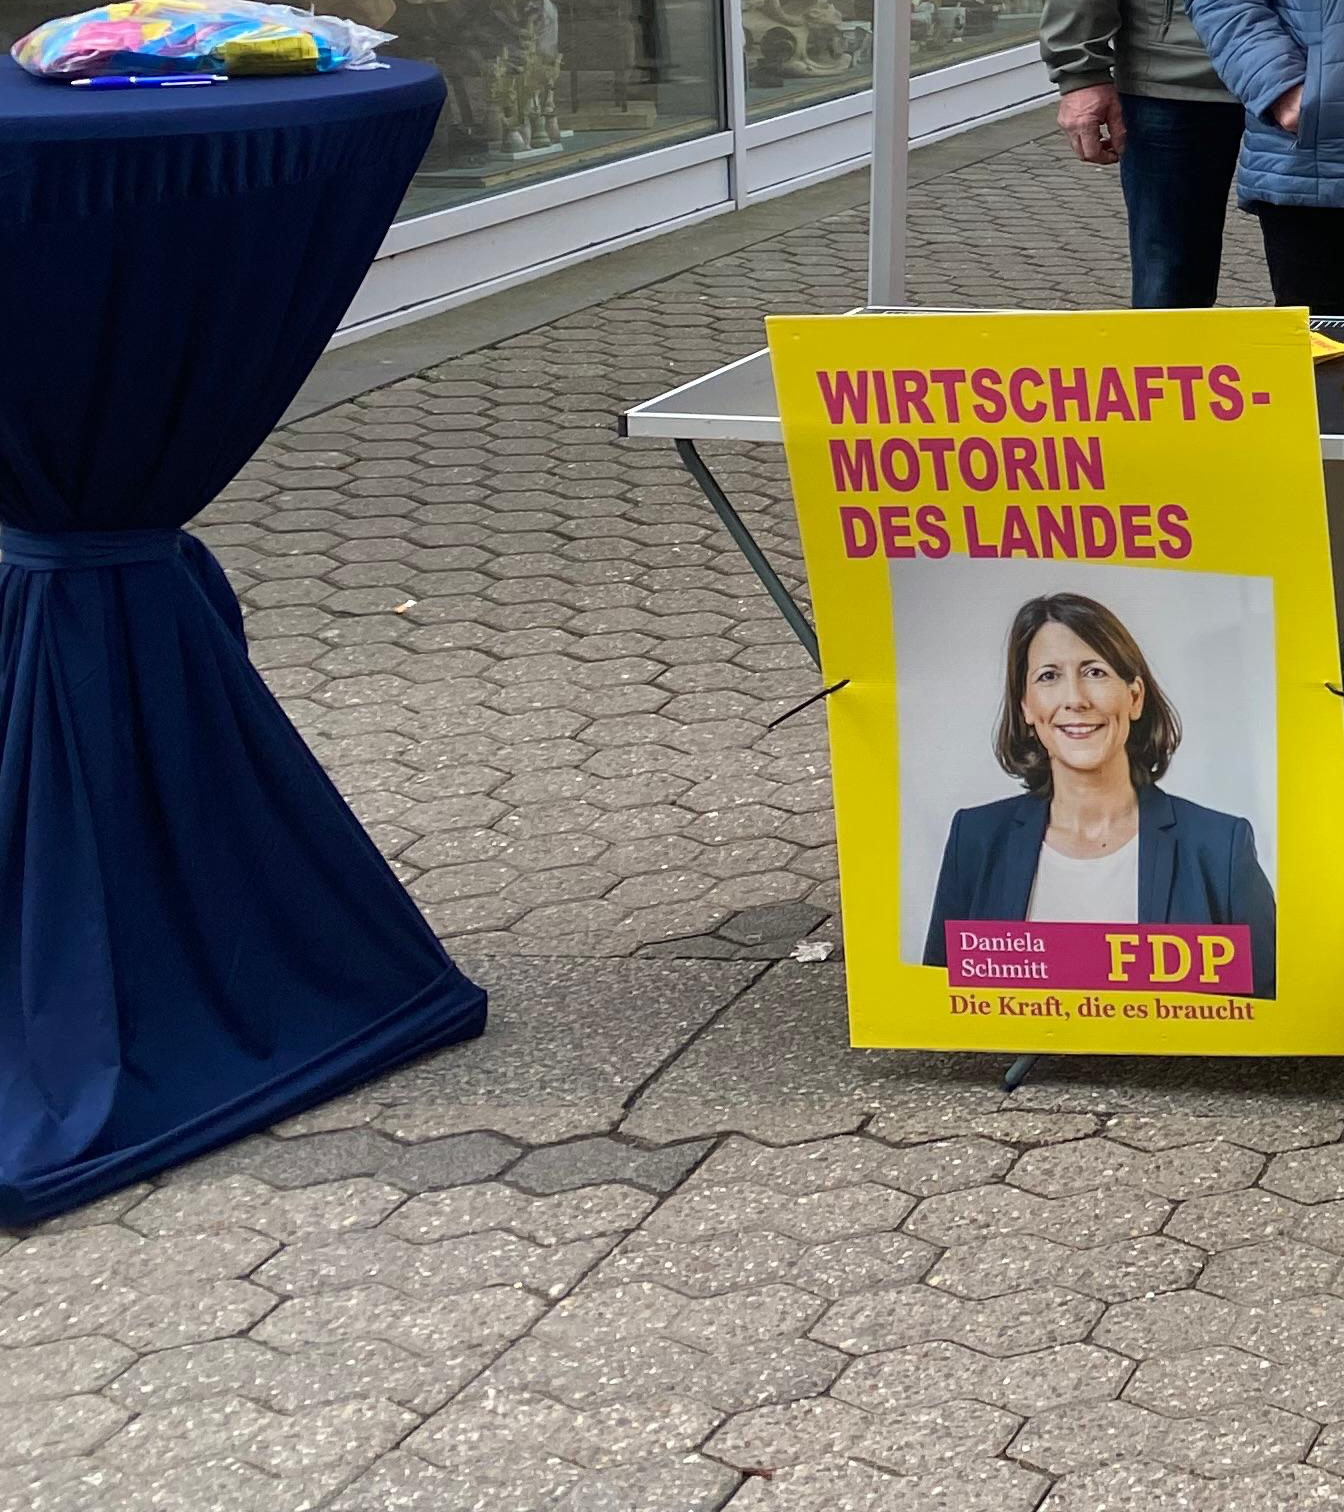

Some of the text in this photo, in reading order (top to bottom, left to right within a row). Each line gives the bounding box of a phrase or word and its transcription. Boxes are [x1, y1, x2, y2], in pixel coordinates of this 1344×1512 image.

[817, 364, 1270, 425] WIRTSCHAFTS-
[829, 436, 1105, 492] MOTORIN
[840, 504, 1193, 559] DES LANDES
[960, 932, 1045, 952] Daniela
[1105, 934, 1235, 983] FDP
[961, 959, 1048, 979] Schmitt
[950, 995, 1254, 1021] Die Kraft, die es braucht
